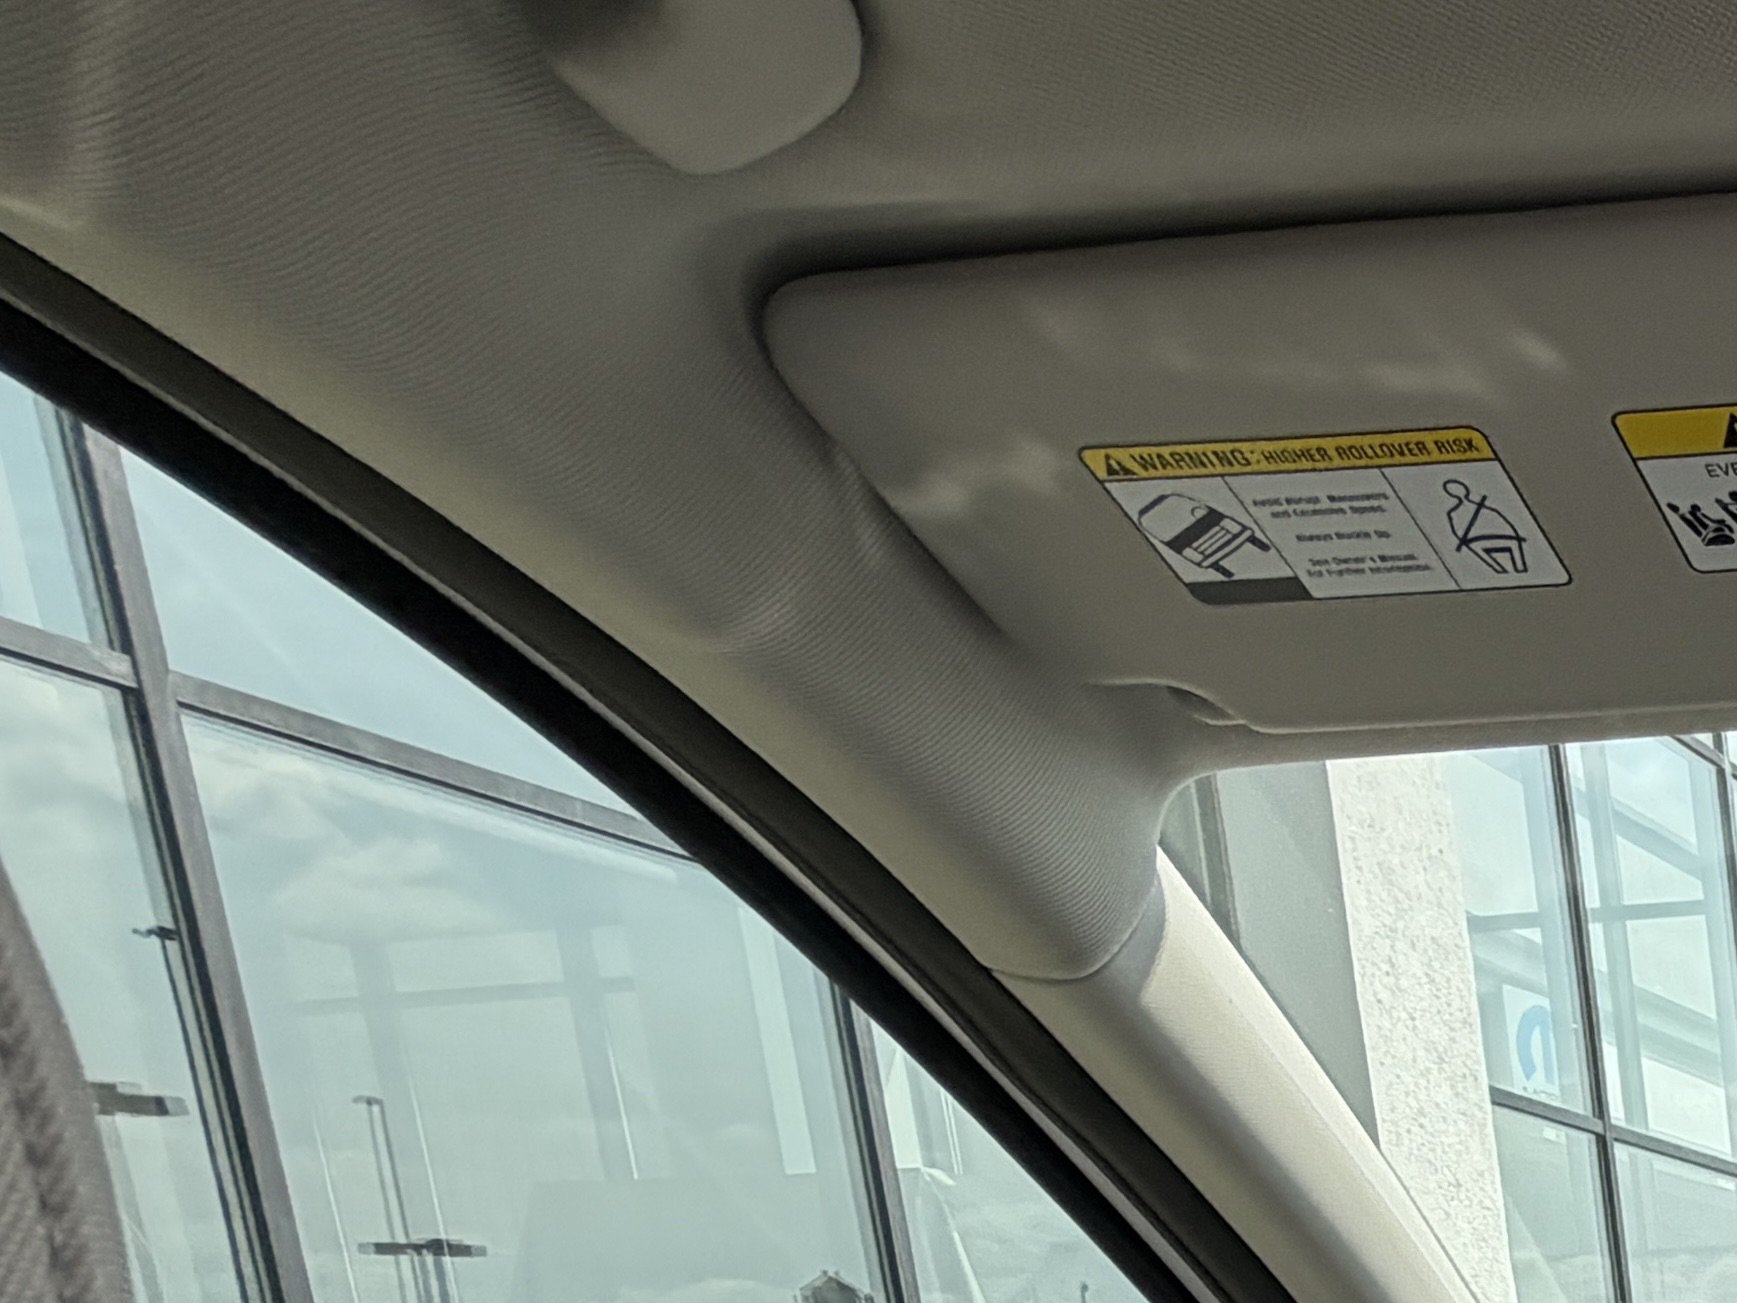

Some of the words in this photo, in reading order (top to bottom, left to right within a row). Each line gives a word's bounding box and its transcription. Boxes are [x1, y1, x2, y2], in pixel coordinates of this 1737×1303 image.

[1263, 445, 1330, 467] HIGHER
[1336, 441, 1432, 463] ROLLOVER
[1436, 437, 1480, 456] RISK
